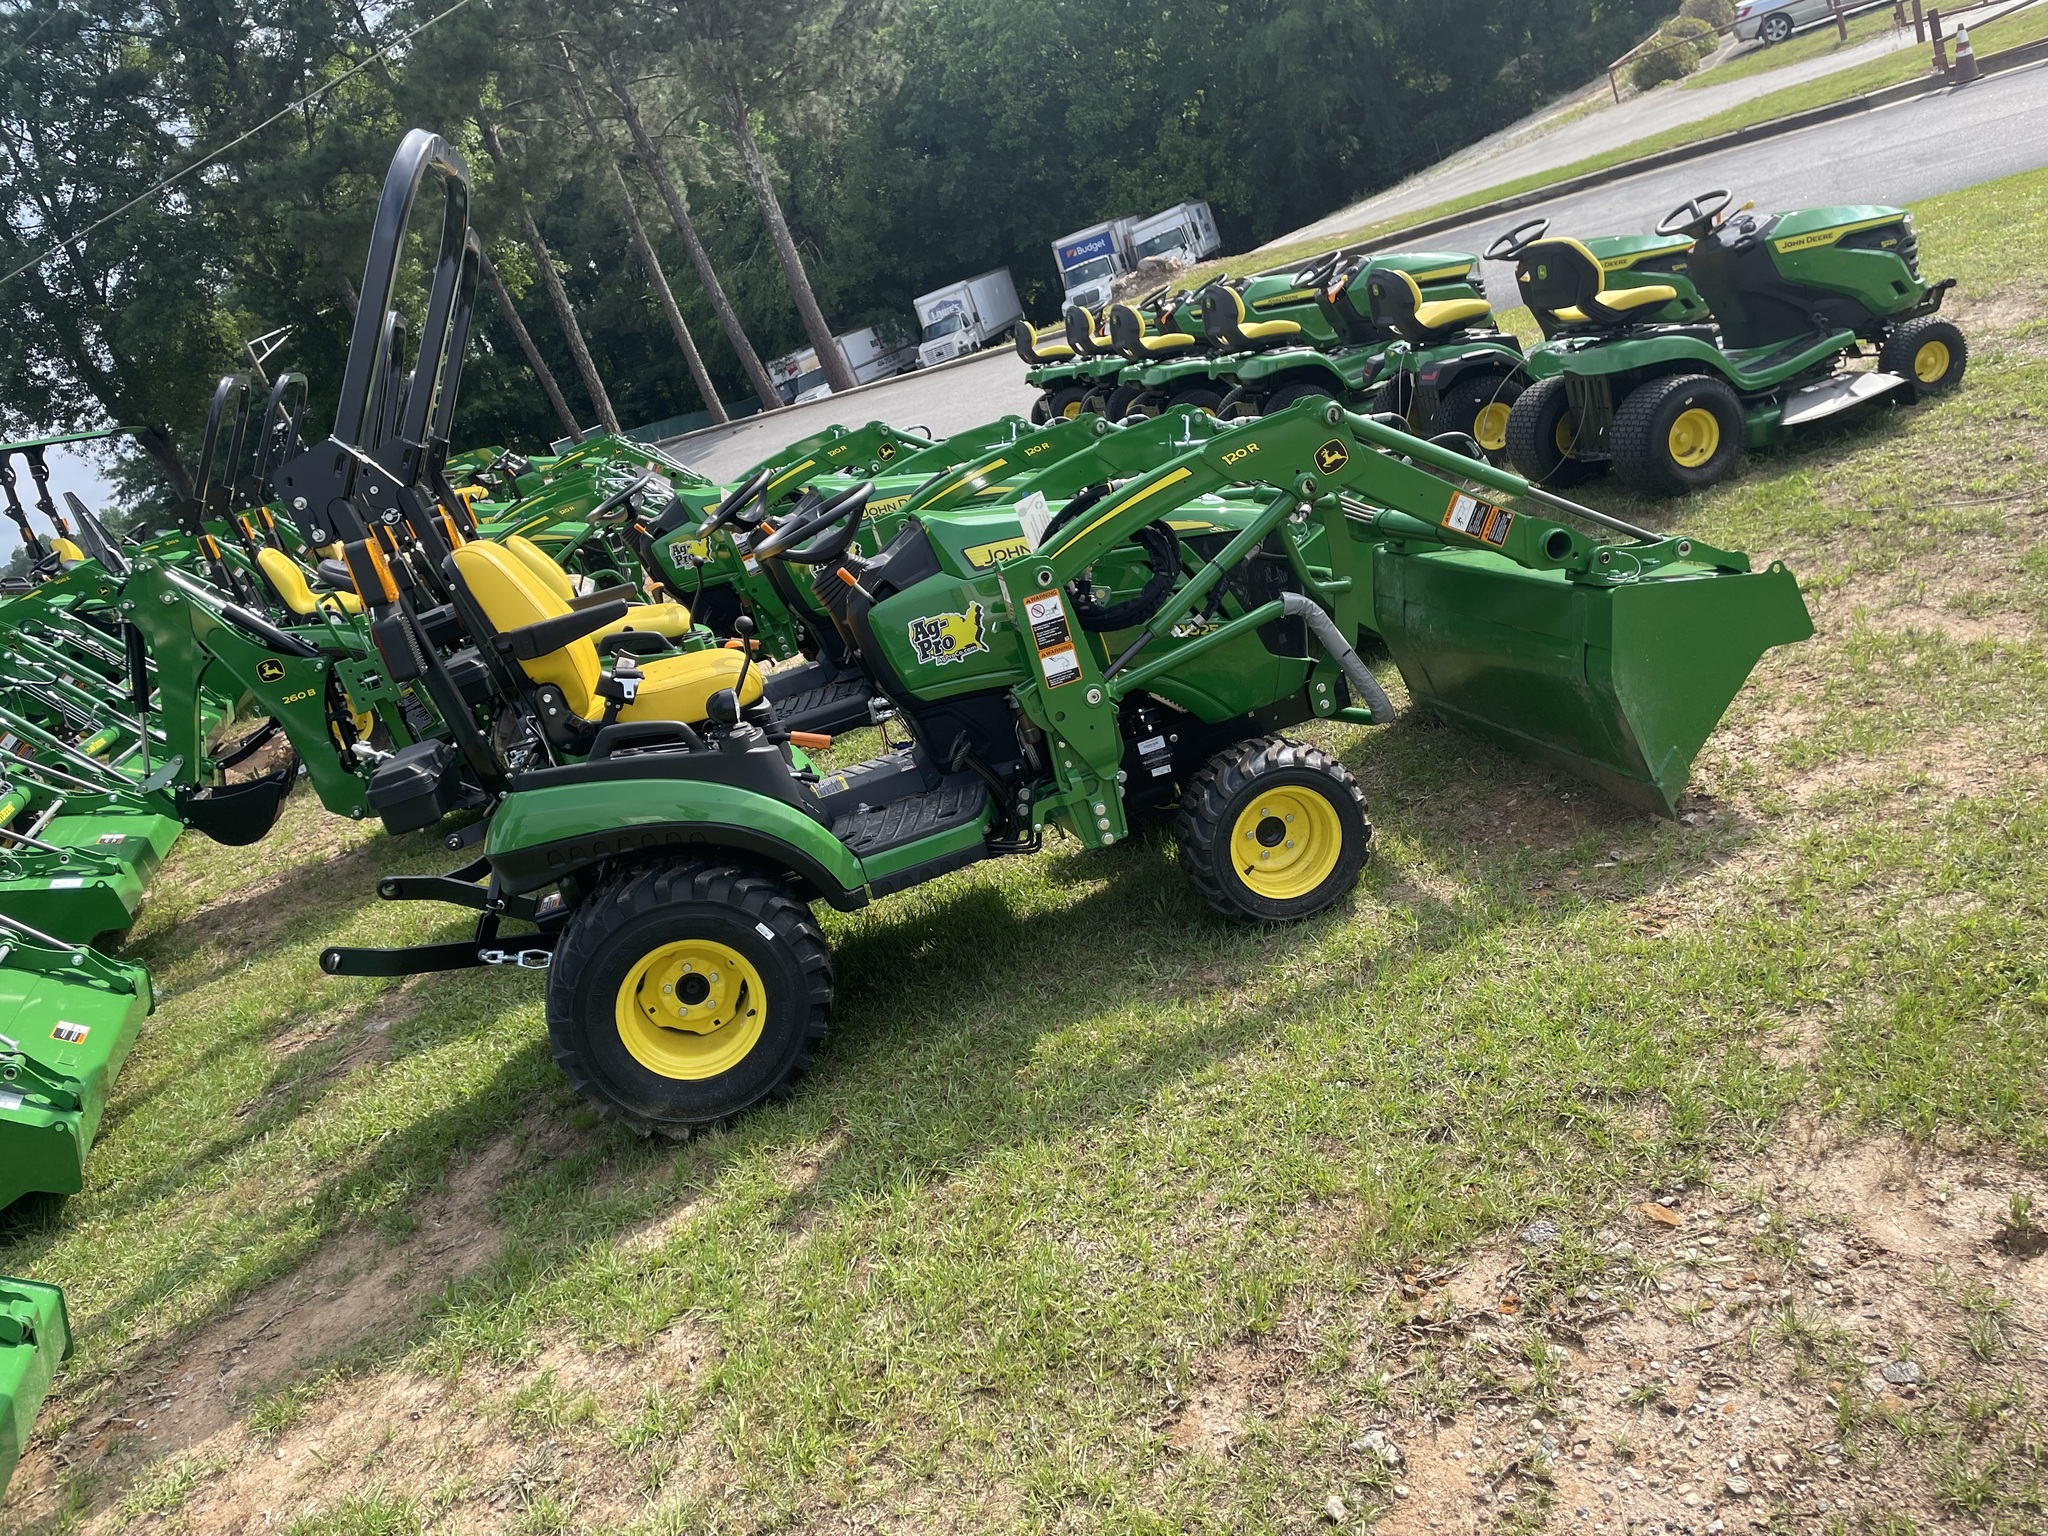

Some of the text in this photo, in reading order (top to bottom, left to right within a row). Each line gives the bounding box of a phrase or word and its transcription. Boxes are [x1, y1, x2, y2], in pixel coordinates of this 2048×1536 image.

[1076, 238, 1106, 255] Budget
[1782, 233, 1833, 249] JOHN DEERE
[862, 502, 897, 518] JOHN
[672, 545, 691, 557] Ag-
[984, 545, 1033, 565] JOHN
[674, 553, 694, 566] Pro
[1030, 589, 1058, 602] WARNING
[913, 620, 947, 643] Ag-
[917, 636, 955, 660] Pro
[937, 645, 977, 663] AgProCo.com
[1045, 643, 1073, 657] WARNING
[282, 691, 306, 705] 260
